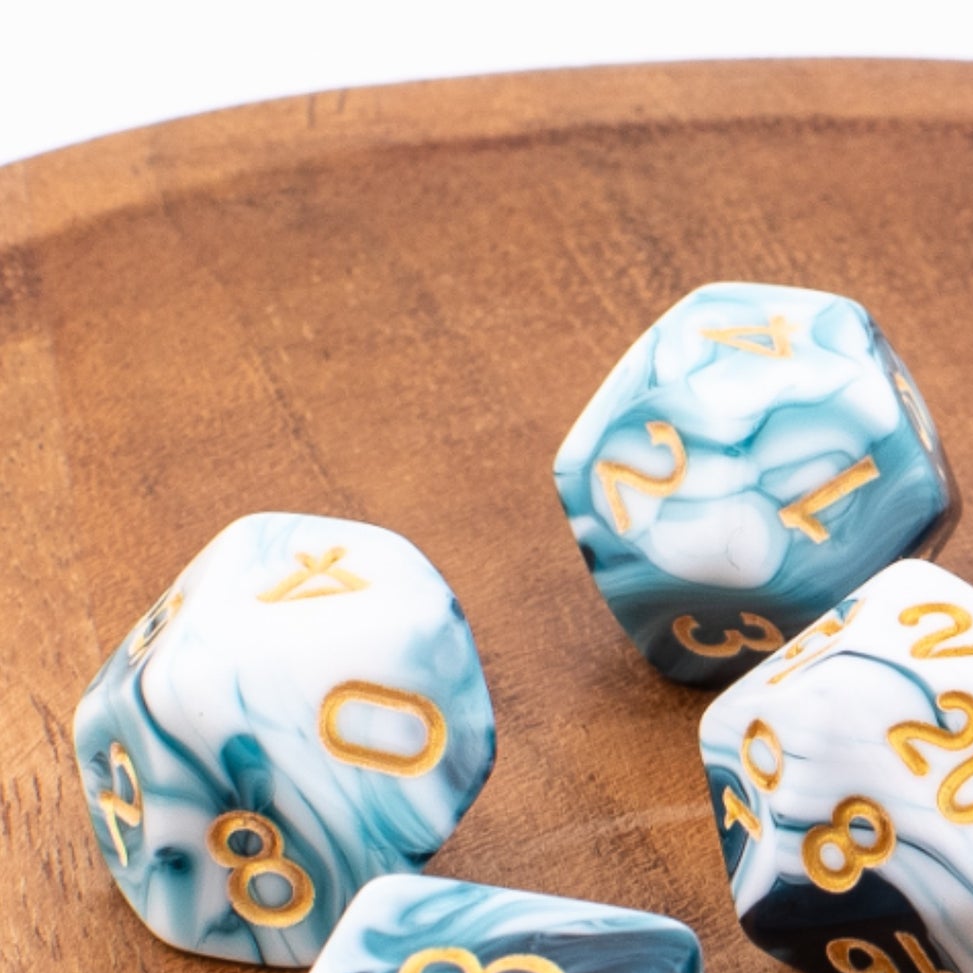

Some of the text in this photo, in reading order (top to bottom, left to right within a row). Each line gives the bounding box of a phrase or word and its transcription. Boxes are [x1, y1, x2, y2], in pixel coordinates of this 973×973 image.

[700, 315, 797, 359] 4
[595, 421, 688, 534] 2
[778, 456, 880, 544] 1
[256, 546, 371, 603] 4
[672, 611, 785, 658] 3
[318, 679, 447, 777] 0
[98, 741, 142, 868] 2
[801, 795, 896, 893] 8
[207, 810, 315, 927] 8
